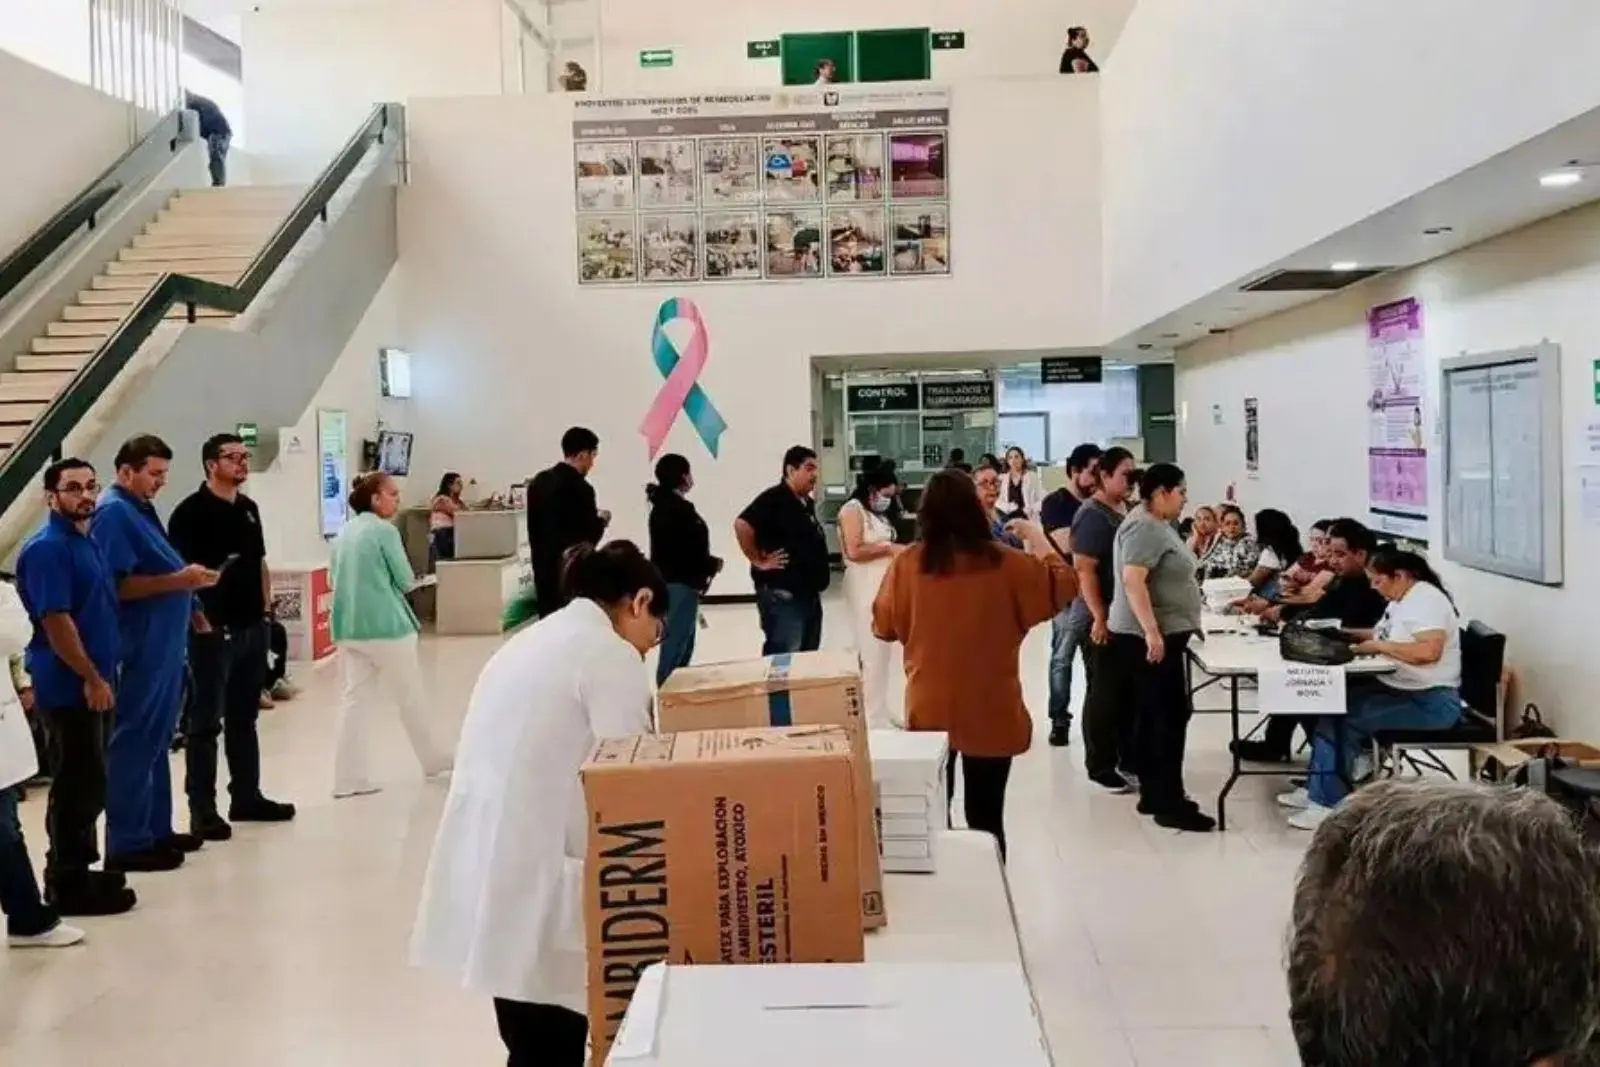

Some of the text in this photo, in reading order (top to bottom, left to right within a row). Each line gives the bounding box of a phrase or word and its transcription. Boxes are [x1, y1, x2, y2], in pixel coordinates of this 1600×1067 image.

[858, 387, 908, 397] CONTROL
[880, 398, 887, 409] 7
[984, 385, 991, 393] Y
[817, 785, 826, 826] MEXICO
[732, 803, 747, 863] ATOXICO
[715, 796, 734, 964] ATEX PARA EXPLORACION
[599, 819, 669, 1041] BIDERM
